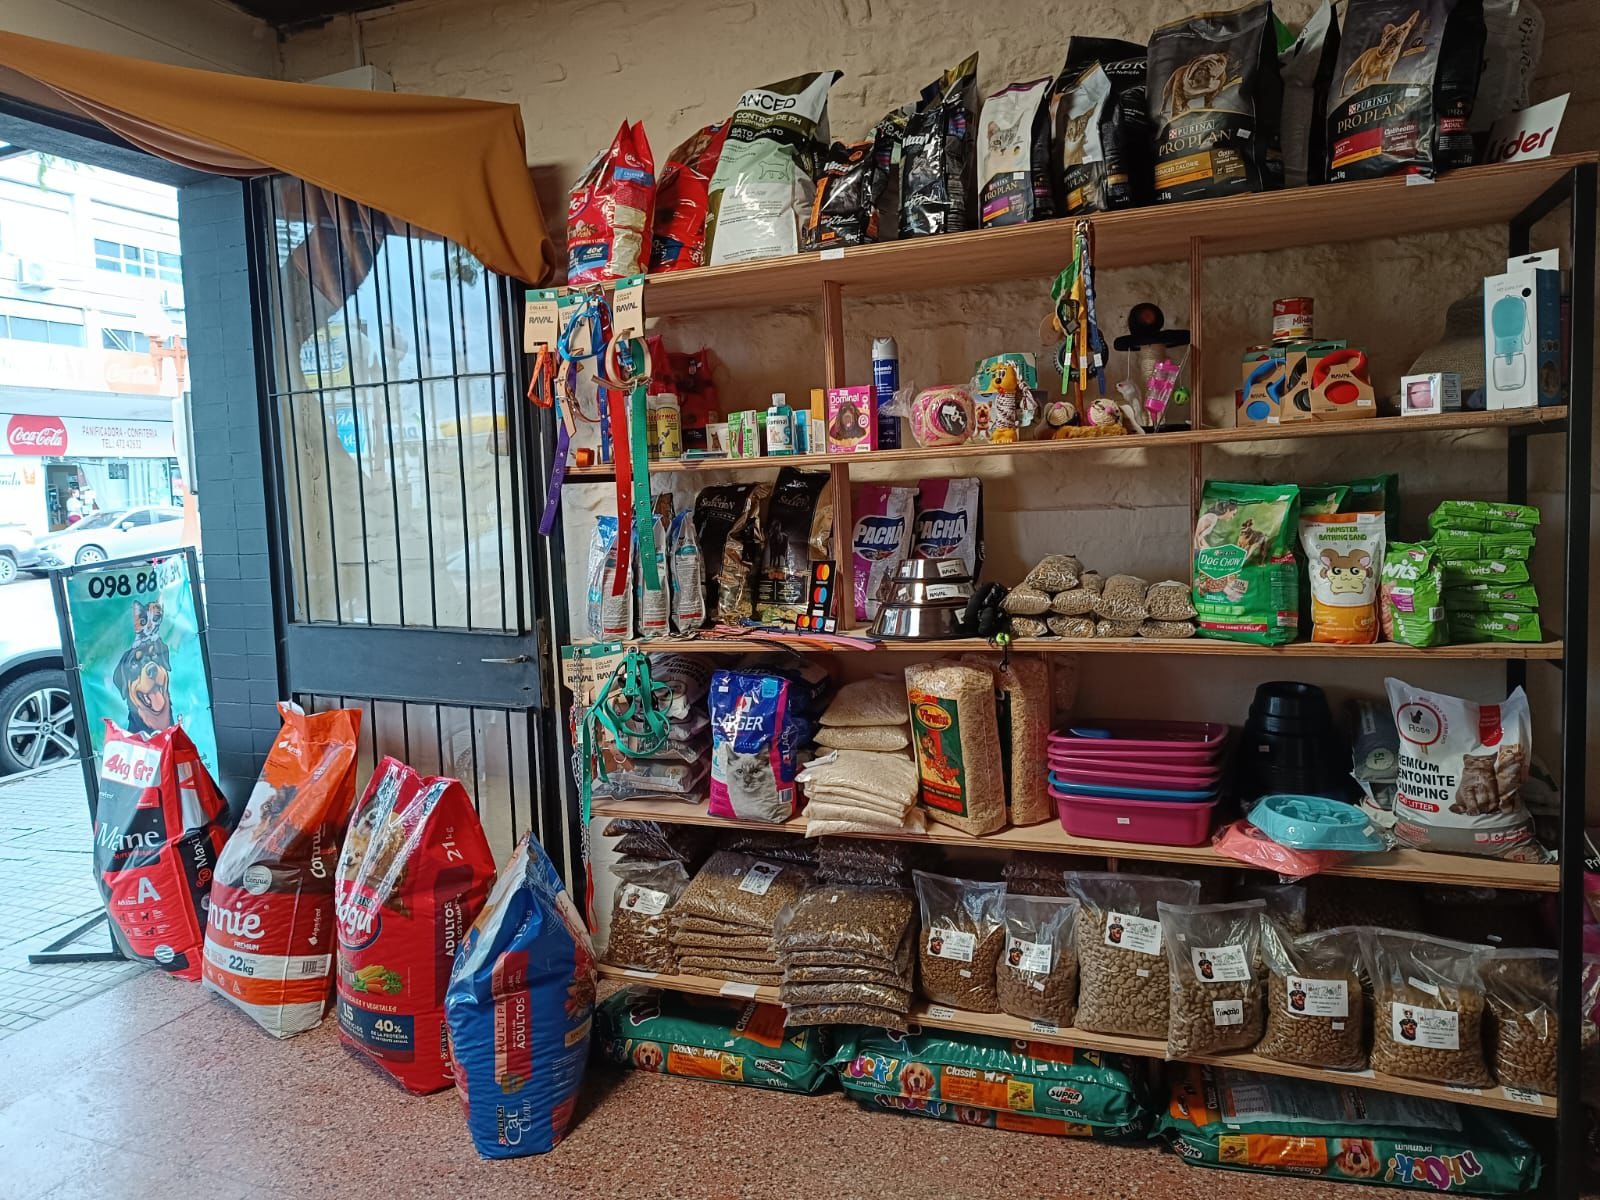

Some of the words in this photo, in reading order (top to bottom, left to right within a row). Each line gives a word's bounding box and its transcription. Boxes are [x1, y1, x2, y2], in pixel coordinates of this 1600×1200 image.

[1178, 120, 1214, 136] PURINA
[1337, 113, 1362, 133] PRO
[1364, 103, 1408, 125] PLAN
[1159, 138, 1185, 156] PRO
[1188, 129, 1232, 148] PLAN
[616, 301, 638, 313] RAVAL
[528, 315, 554, 325] RAVAL
[830, 392, 860, 405] Dominal
[9, 426, 65, 447] Coca-Cola
[854, 520, 905, 545] PACHÁ
[1200, 554, 1218, 565] DOG
[1219, 557, 1241, 567] CHOW
[88, 564, 132, 598] 098
[136, 572, 158, 594] 88
[104, 753, 131, 781] 4kg
[1408, 799, 1434, 812] LITTER
[137, 876, 161, 904] A
[444, 901, 455, 957] ADULTOS
[228, 954, 254, 976] 22kg
[342, 1002, 354, 1021] 15
[516, 997, 526, 1049] ADULTOS
[945, 1065, 977, 1079] Classic
[1050, 1088, 1081, 1101] SUPRA
[504, 1109, 522, 1145] Cat
[1394, 1143, 1433, 1153] premium
